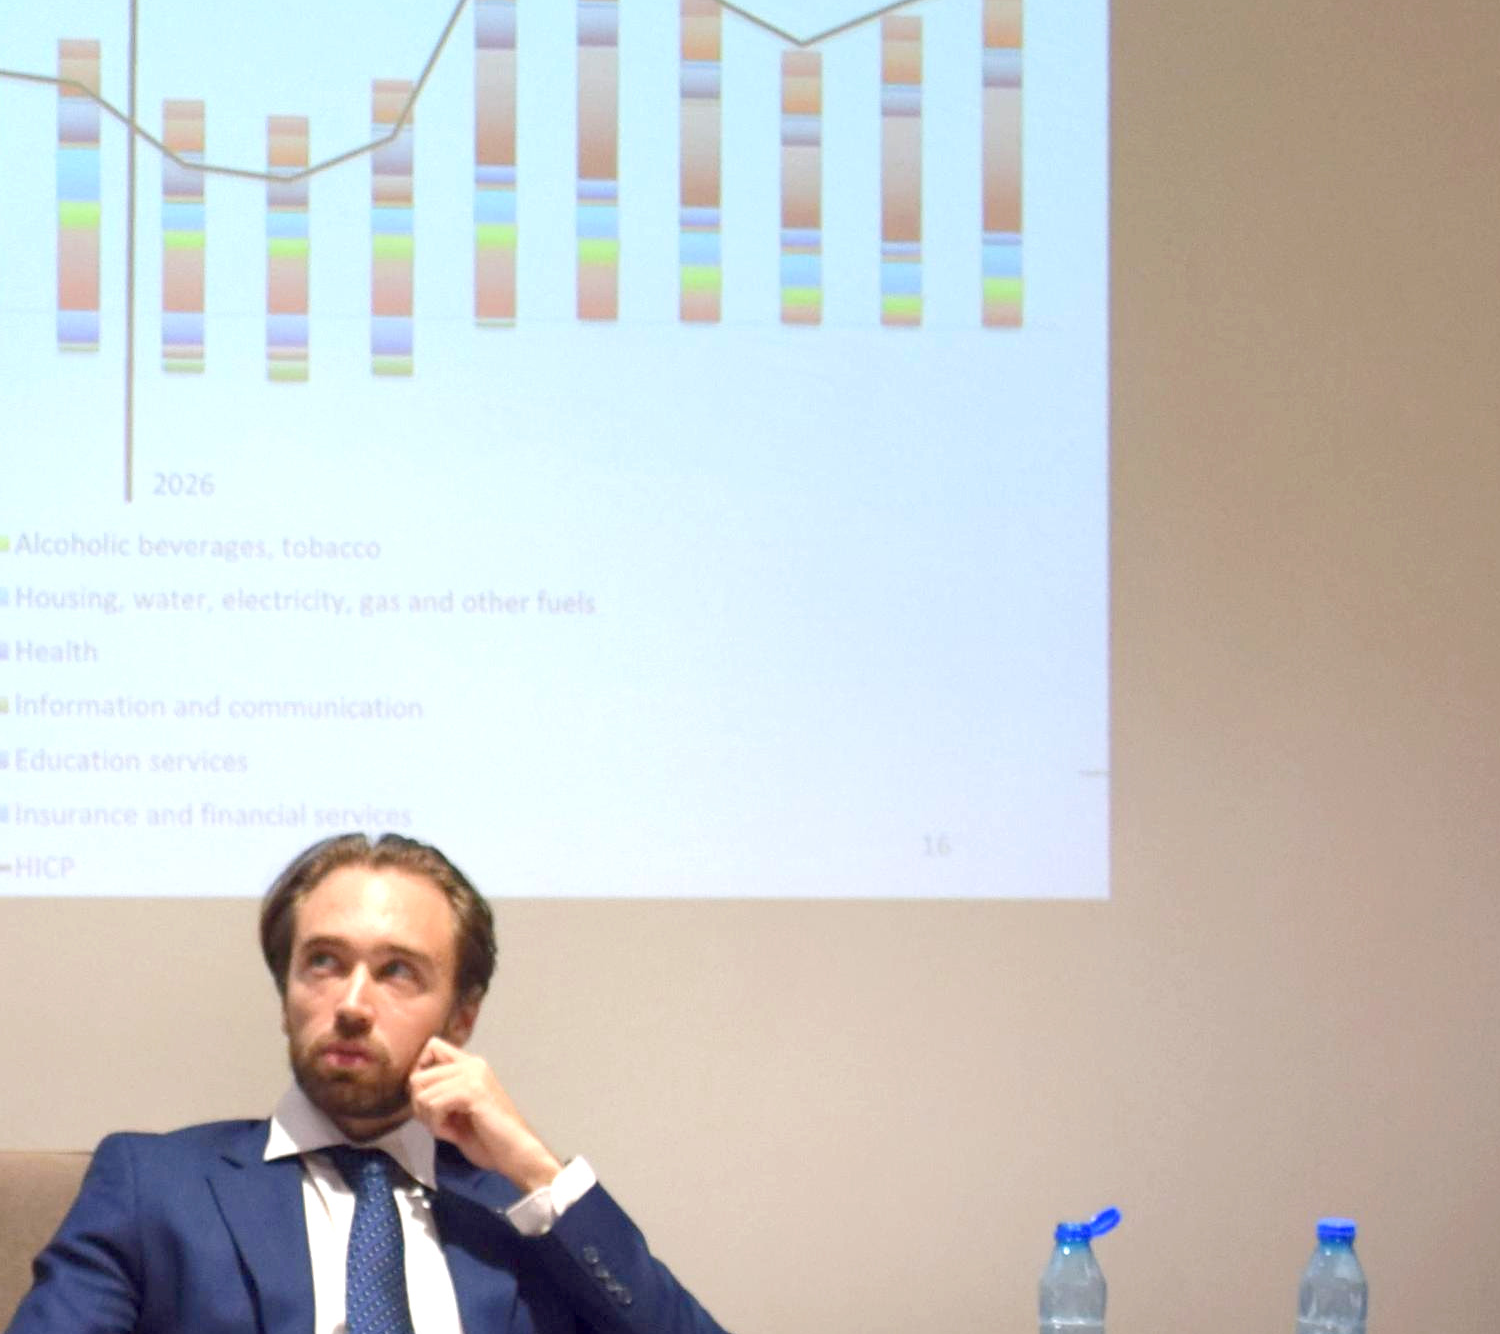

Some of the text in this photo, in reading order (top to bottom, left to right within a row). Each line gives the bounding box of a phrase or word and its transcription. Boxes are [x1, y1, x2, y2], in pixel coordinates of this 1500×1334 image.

[152, 470, 216, 497] 2026
[13, 532, 382, 563] Alcoholic beverages, tobacco
[14, 586, 596, 617] Housing, water, electricity, gas and other fuels
[14, 640, 99, 663] Health
[14, 693, 424, 720] Information and communication
[14, 748, 250, 773] Education services
[14, 801, 413, 828] Insurance and financial services
[14, 856, 77, 880] HICP
